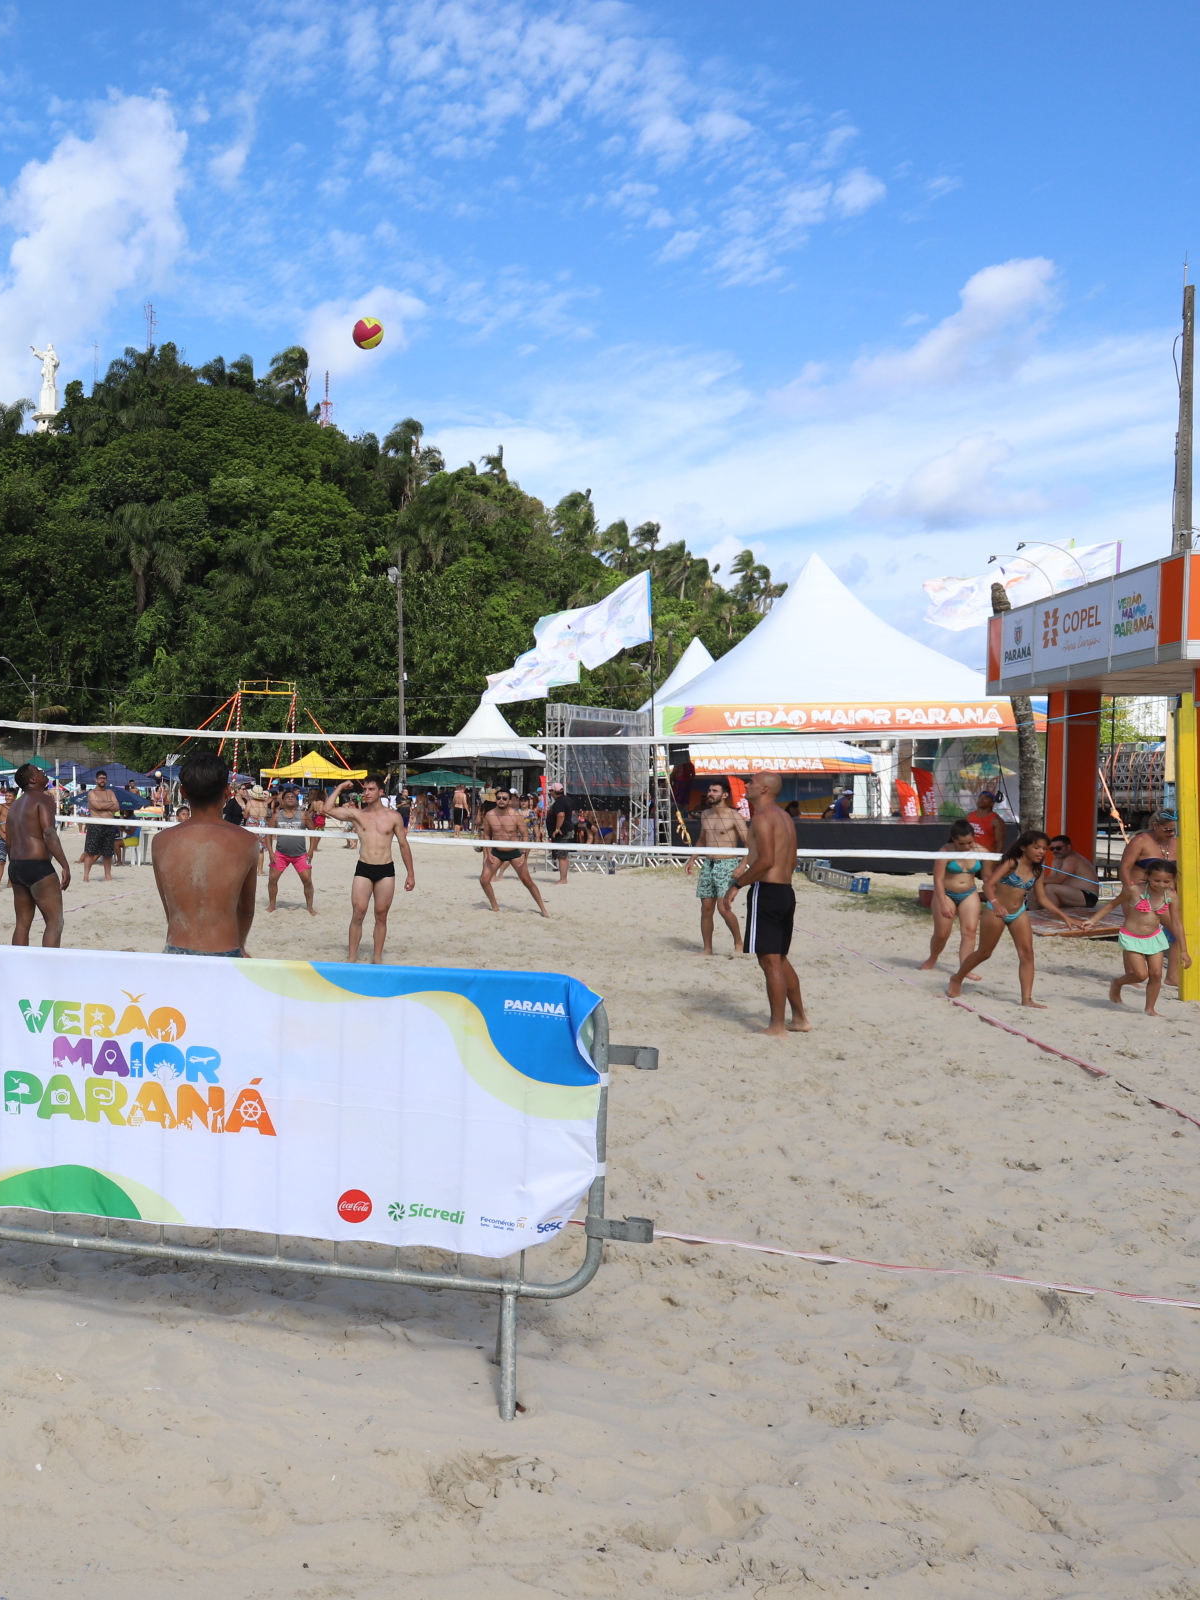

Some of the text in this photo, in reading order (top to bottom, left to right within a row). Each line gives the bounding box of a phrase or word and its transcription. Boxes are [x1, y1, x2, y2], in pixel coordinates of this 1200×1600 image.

[1117, 591, 1142, 610] VERÃO
[1062, 605, 1101, 634] COPEL
[1121, 604, 1147, 620] MAIOR
[1114, 611, 1154, 638] PARANÁ
[1004, 643, 1032, 662] PARANÁ
[724, 704, 1004, 727] VERÃO MAIOR PARANÁ
[695, 758, 749, 770] MAIOR
[18, 990, 186, 1042] VERÃO
[504, 1000, 566, 1015] PARANÁ
[52, 1036, 221, 1083] MAIOR
[3, 1070, 277, 1136] PARANÁ
[408, 1203, 466, 1225] Sicredi
[480, 1216, 515, 1228] Fecomércio
